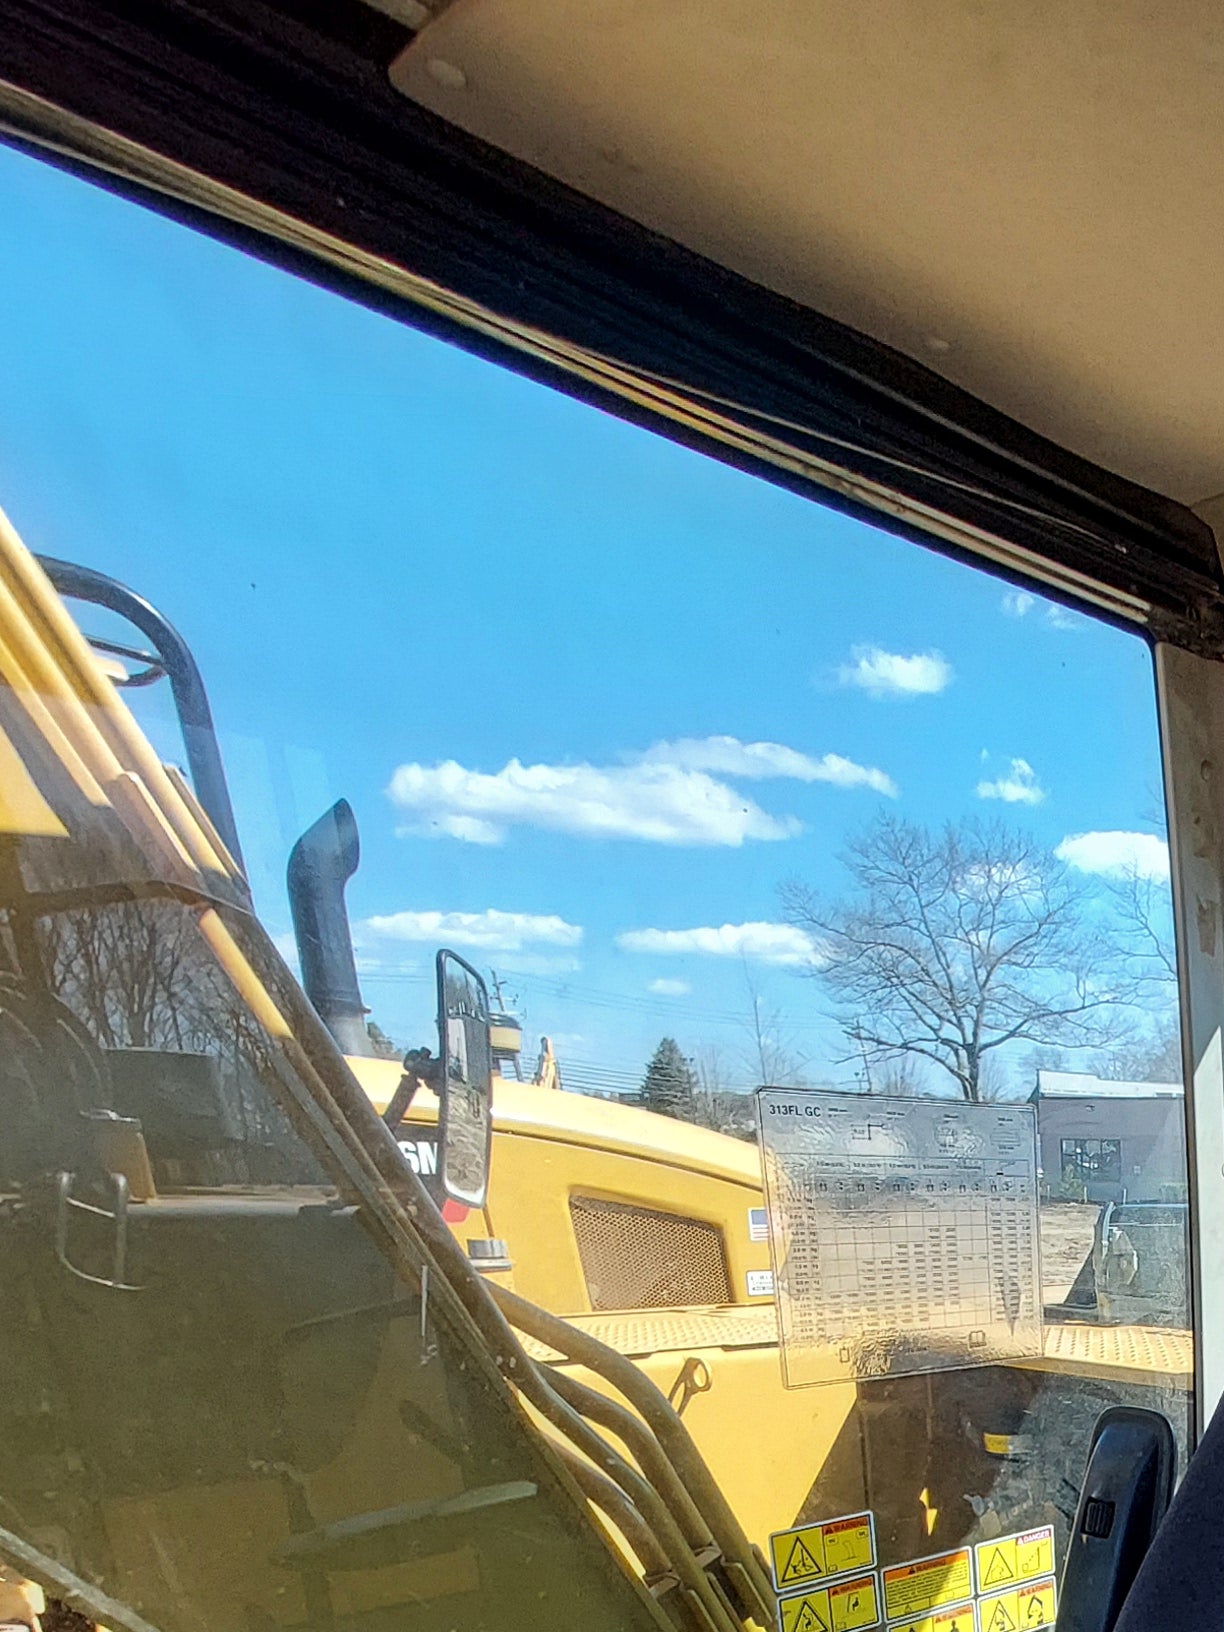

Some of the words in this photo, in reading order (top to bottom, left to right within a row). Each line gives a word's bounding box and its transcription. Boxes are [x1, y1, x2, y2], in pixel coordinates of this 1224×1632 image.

[769, 1104, 802, 1116] 313FL
[805, 1106, 821, 1117] GC
[1023, 1530, 1049, 1543] DANGER
